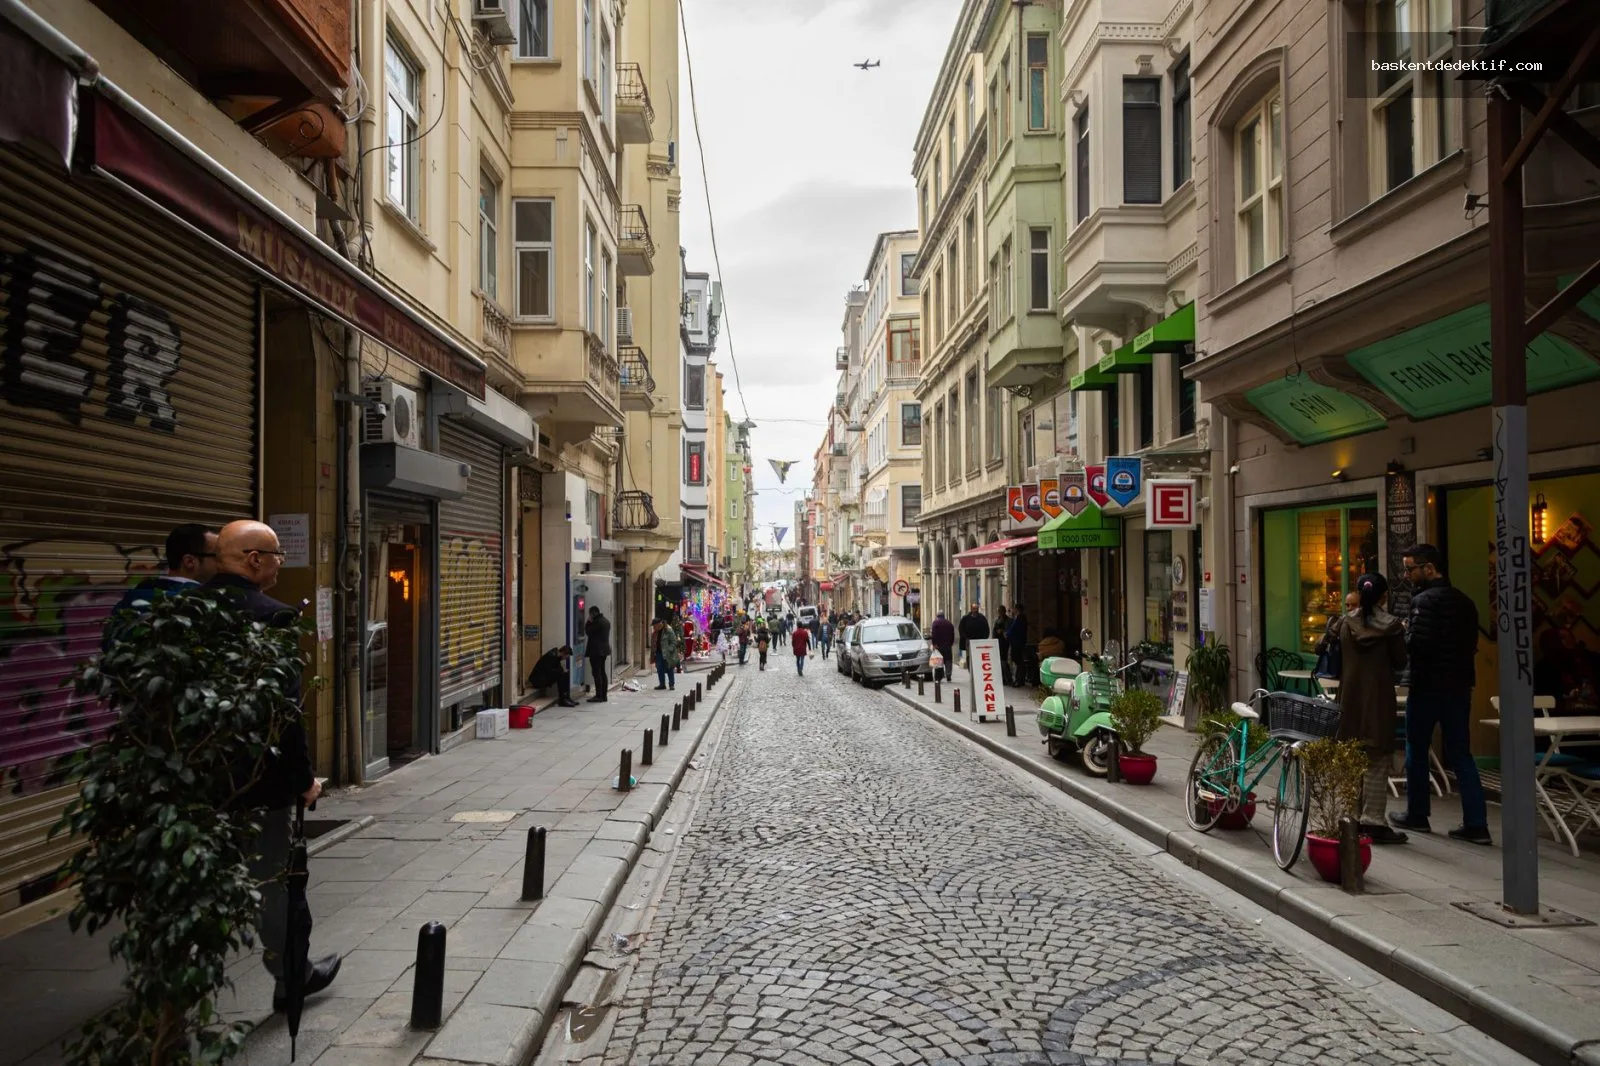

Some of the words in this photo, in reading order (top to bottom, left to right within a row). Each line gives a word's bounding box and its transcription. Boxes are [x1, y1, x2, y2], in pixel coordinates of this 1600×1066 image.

[1390, 360, 1453, 393] FIRIN
[1447, 341, 1539, 376] BAK
[1161, 490, 1184, 519] E
[1063, 535, 1080, 543] FOOD
[1082, 533, 1101, 543] STORY
[981, 652, 997, 713] ECZANE
